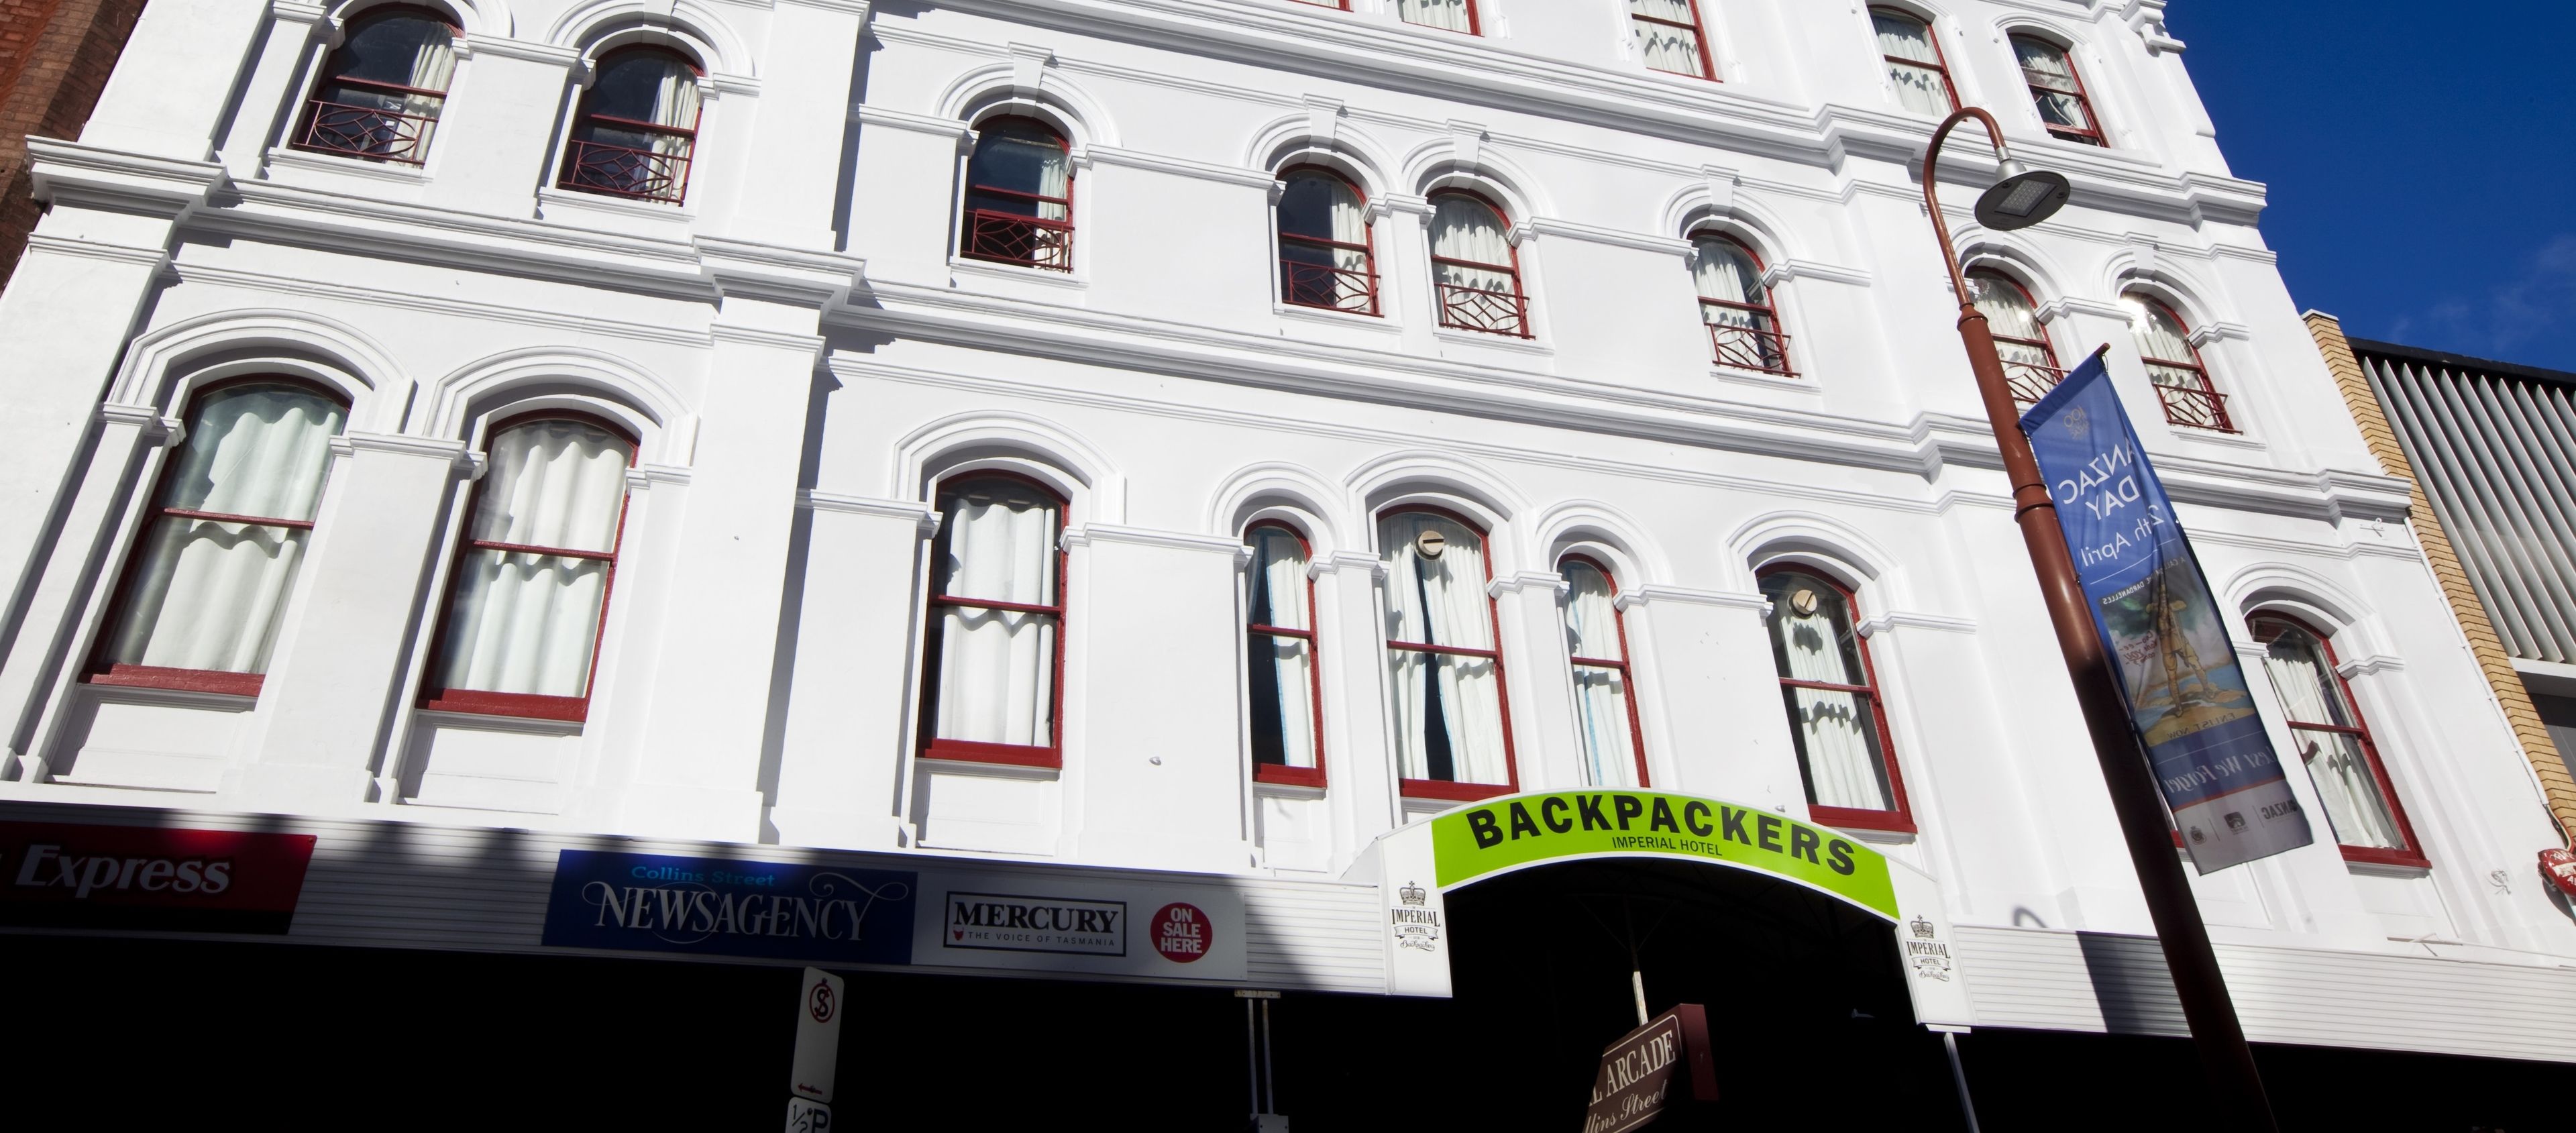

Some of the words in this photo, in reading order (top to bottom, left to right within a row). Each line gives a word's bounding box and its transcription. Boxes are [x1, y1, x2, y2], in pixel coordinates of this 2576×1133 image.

[1466, 794, 1856, 876] BACKPACKERS
[1612, 837, 1676, 849] IMPERIAL
[1680, 839, 1723, 856] HOTEL
[15, 843, 232, 899] Express
[630, 865, 704, 883] Collins
[711, 871, 777, 887] Street
[582, 872, 908, 941] NEWSAGENCY
[1170, 907, 1193, 923] ON
[953, 901, 1119, 934] MERCURY
[1391, 908, 1440, 927] IMPERIAL
[968, 931, 989, 940] THE
[996, 933, 1030, 942] VOICE
[1037, 935, 1051, 943] OF
[1057, 936, 1115, 947] TASMANIA
[1162, 921, 1201, 938] SALE
[1404, 926, 1428, 934] HOTEL
[1160, 937, 1203, 953] HERE
[1907, 940, 1951, 959] IMPERIAL
[1588, 1085, 1603, 1107] L
[1606, 1029, 1676, 1097] ARCADE
[1581, 1112, 1616, 1133] llins
[1620, 1078, 1668, 1121] Street
